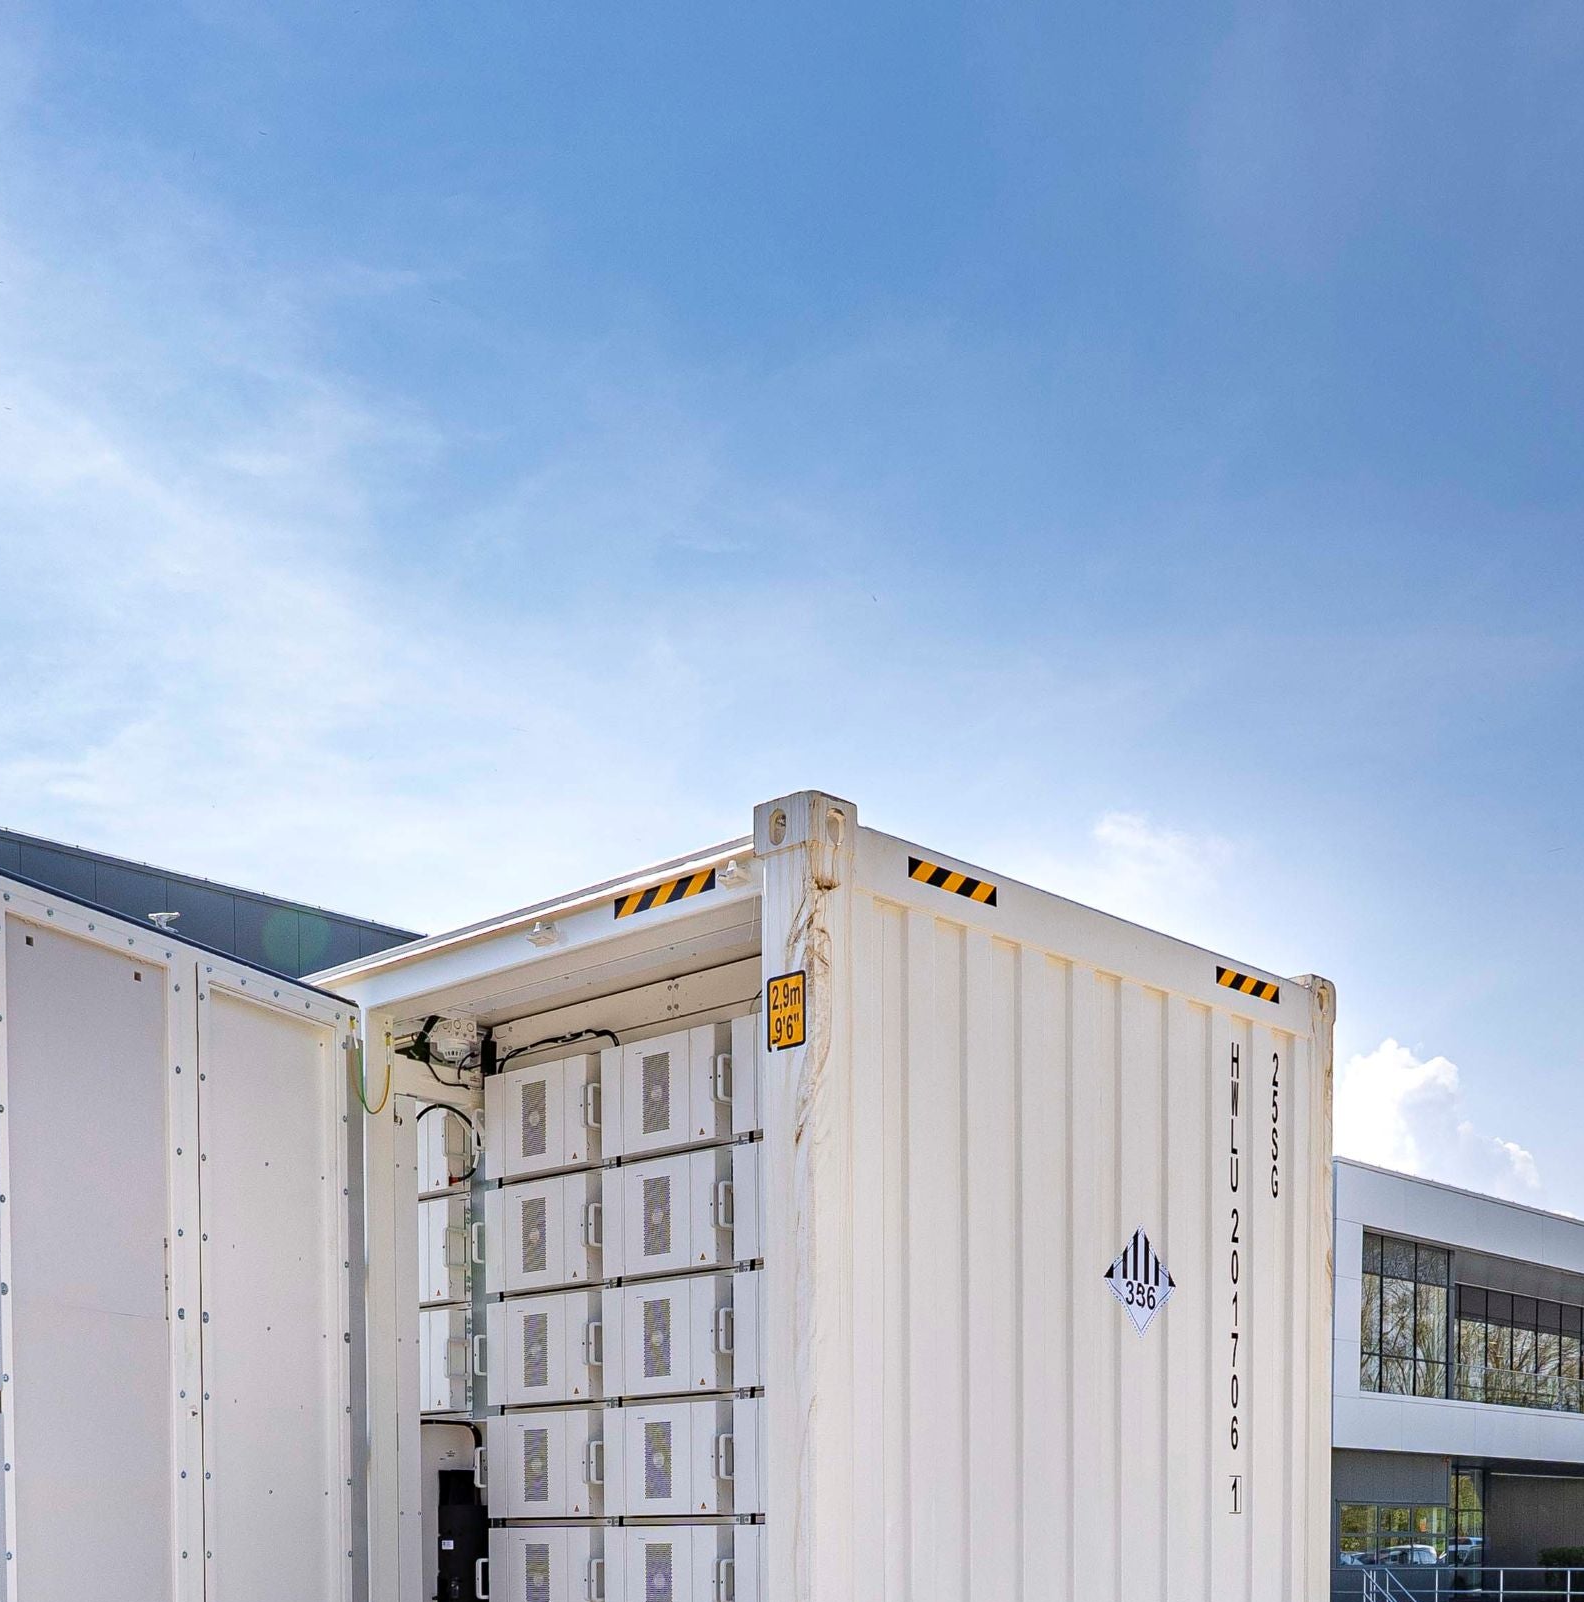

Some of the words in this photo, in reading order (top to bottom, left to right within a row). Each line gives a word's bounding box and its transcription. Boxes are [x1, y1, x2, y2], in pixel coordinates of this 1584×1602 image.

[772, 982, 801, 1013] 2,9m
[1230, 1041, 1240, 1193] HWLU
[1270, 1052, 1279, 1199] 25SG
[1230, 1208, 1239, 1451] 201706
